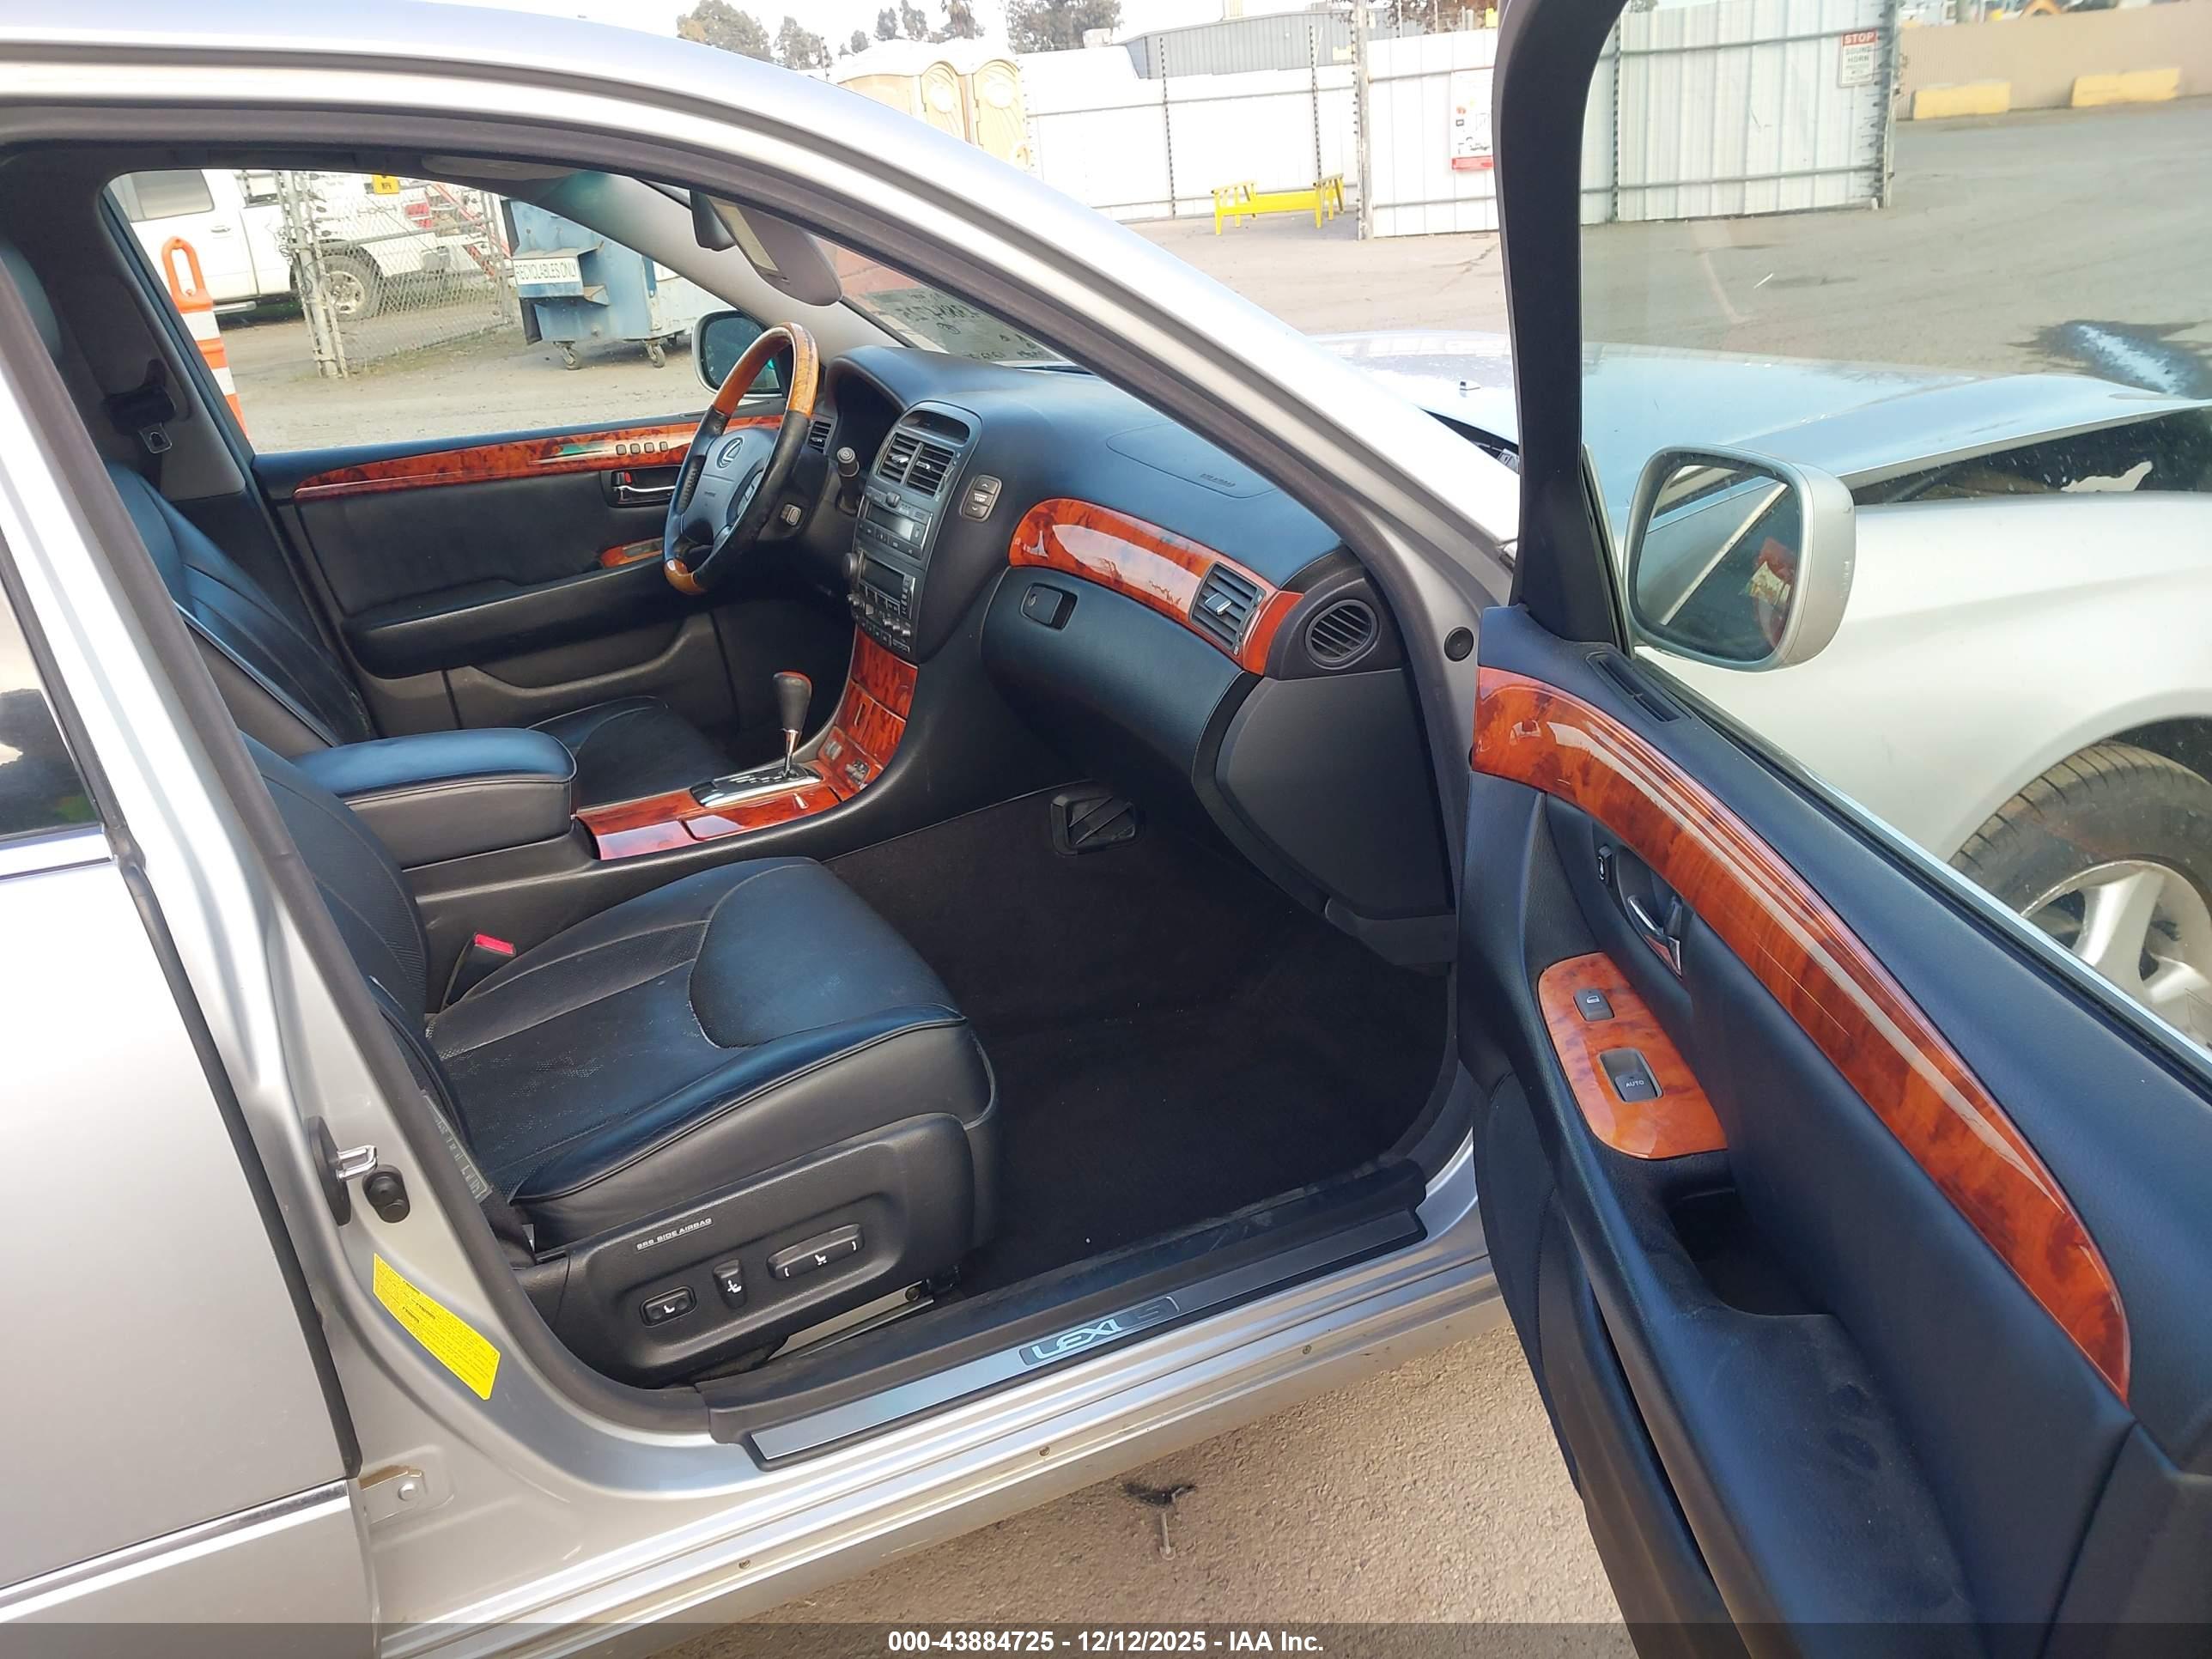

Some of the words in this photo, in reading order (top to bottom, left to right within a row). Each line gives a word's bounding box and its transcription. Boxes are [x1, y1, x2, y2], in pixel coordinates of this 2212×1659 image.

[1844, 32, 1875, 44] STOP
[1848, 54, 1869, 63] HORN
[515, 263, 561, 280] RECYCLABLES
[561, 262, 577, 278] ONLY
[1626, 1079, 1645, 1088] AUTO
[657, 1230, 678, 1243] SIDE
[678, 1218, 713, 1235] AIRBAG
